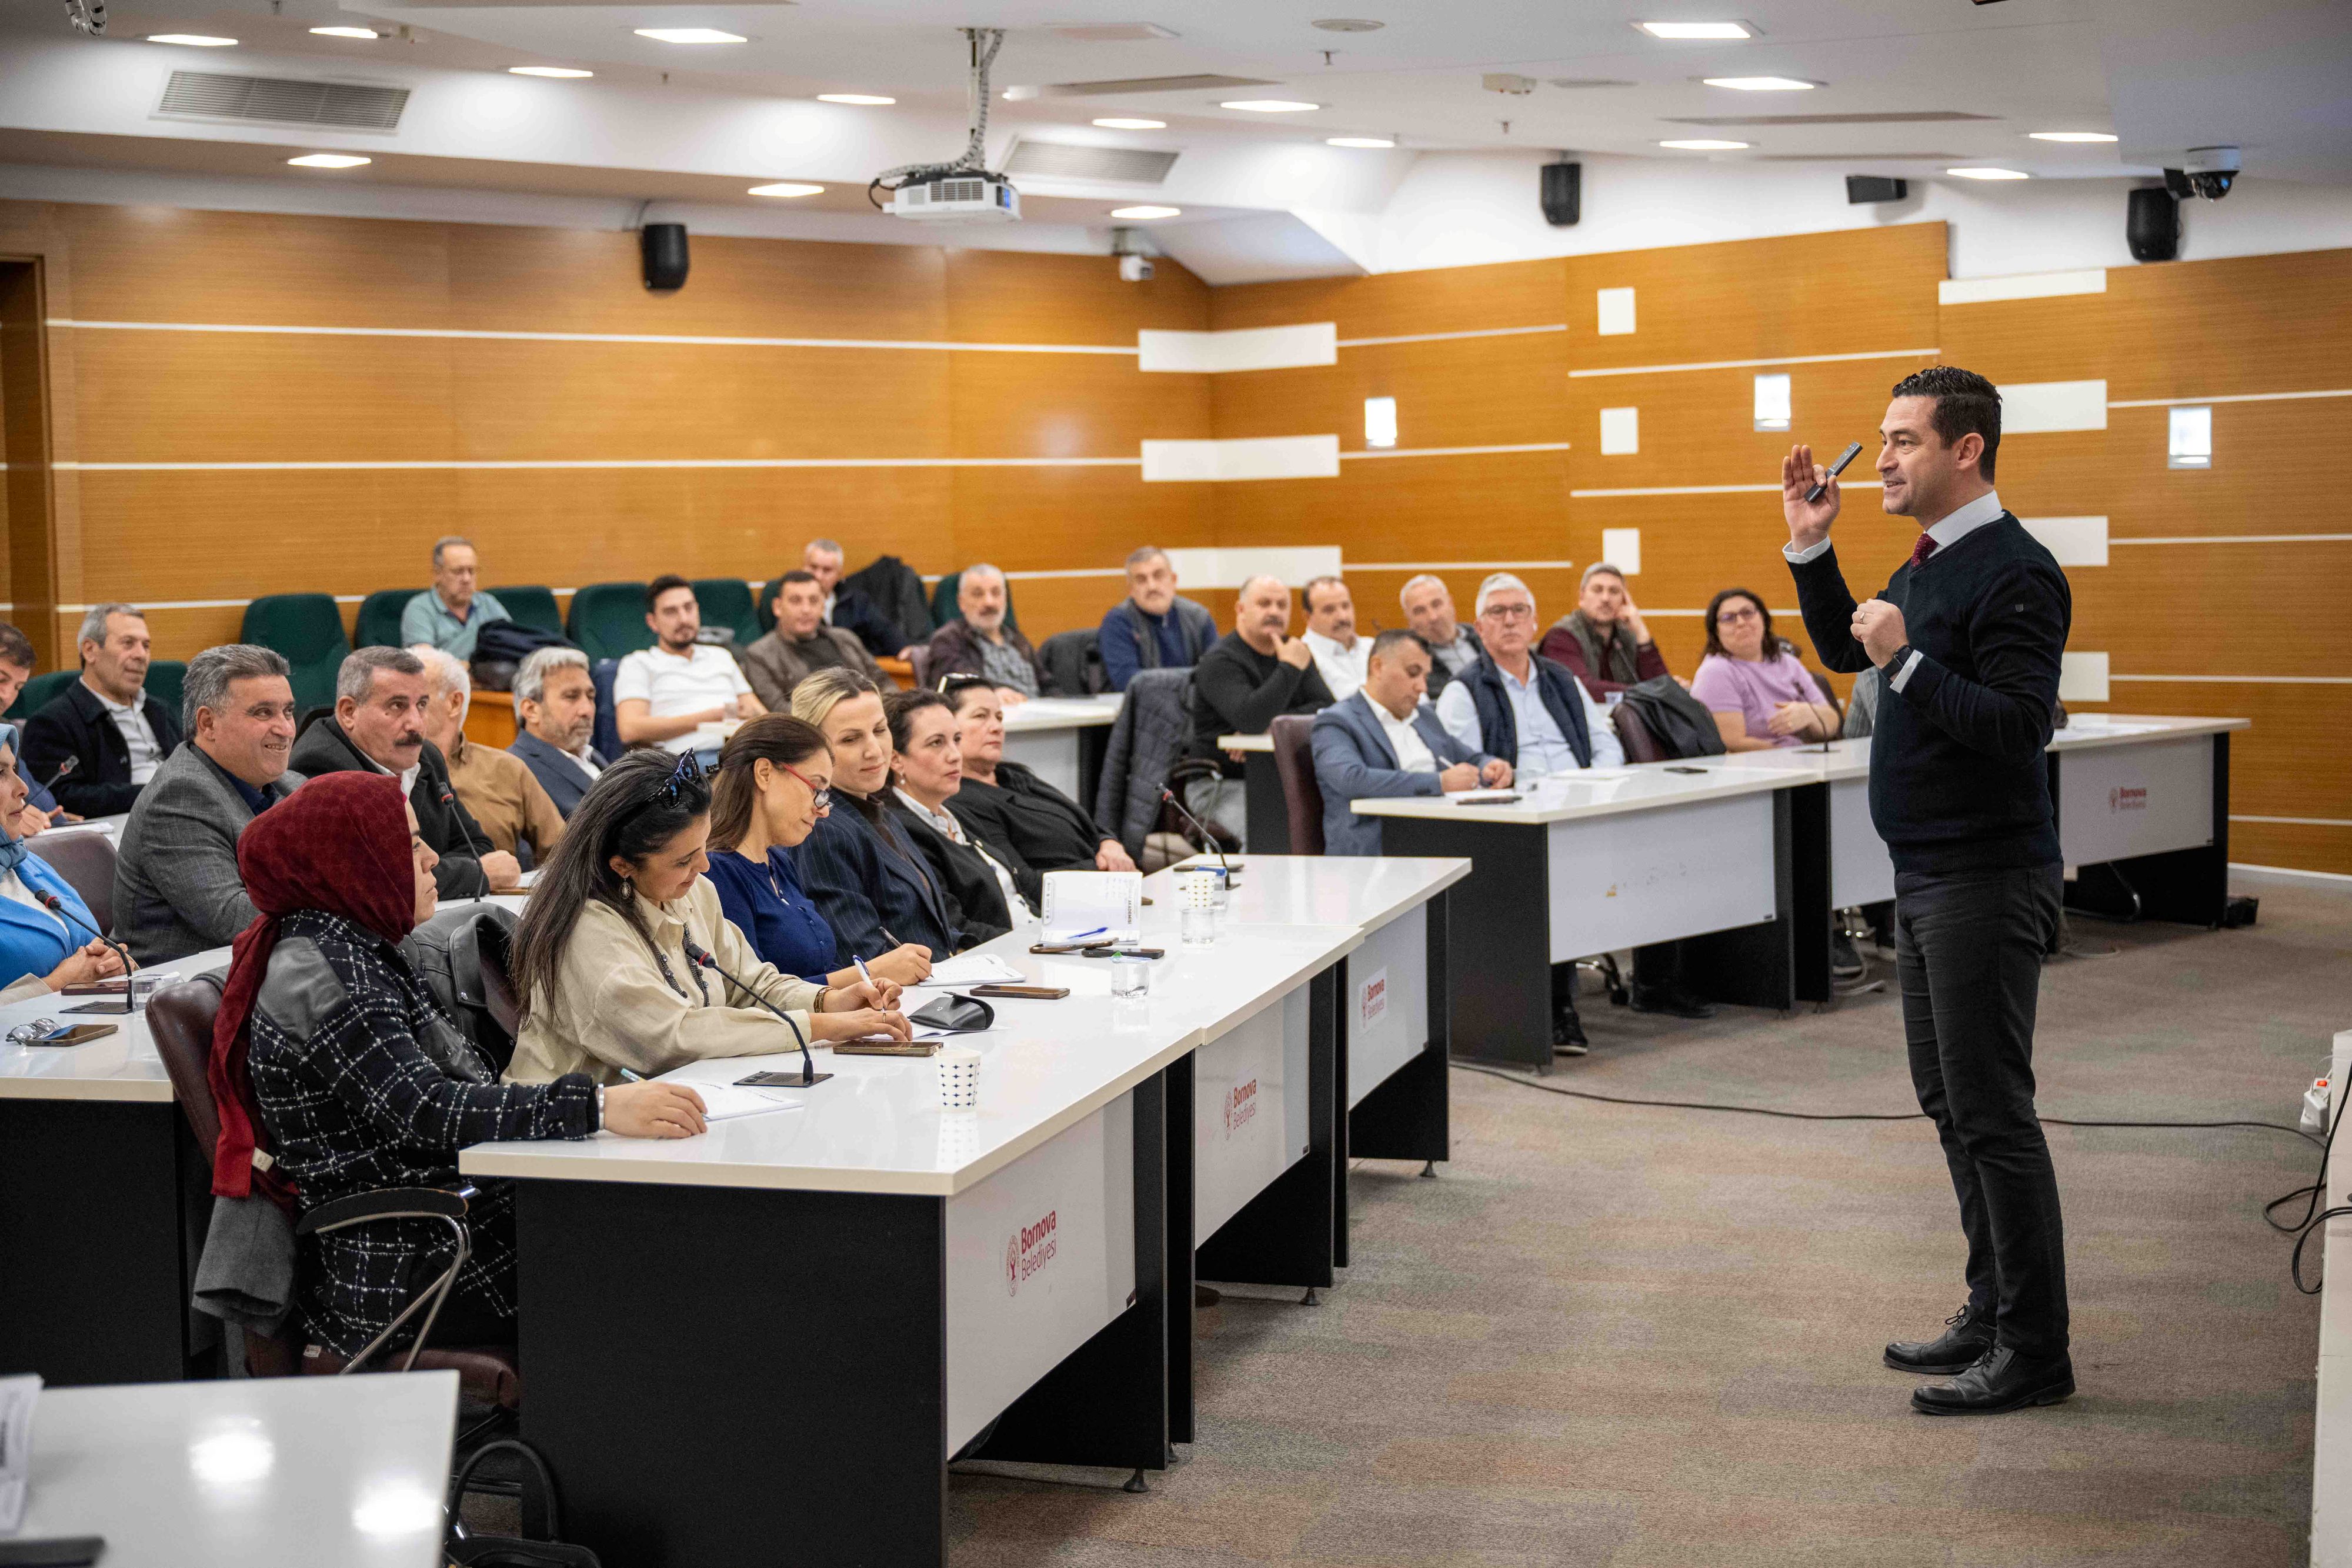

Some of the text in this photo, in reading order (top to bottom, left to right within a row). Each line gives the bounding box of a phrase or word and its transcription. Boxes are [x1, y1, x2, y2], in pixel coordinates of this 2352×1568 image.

[1233, 1078, 1256, 1109] Bornova
[1233, 1097, 1256, 1130] Belediyesi
[1021, 1210, 1056, 1255] Bornova
[1022, 1233, 1056, 1280] Belediyesi
